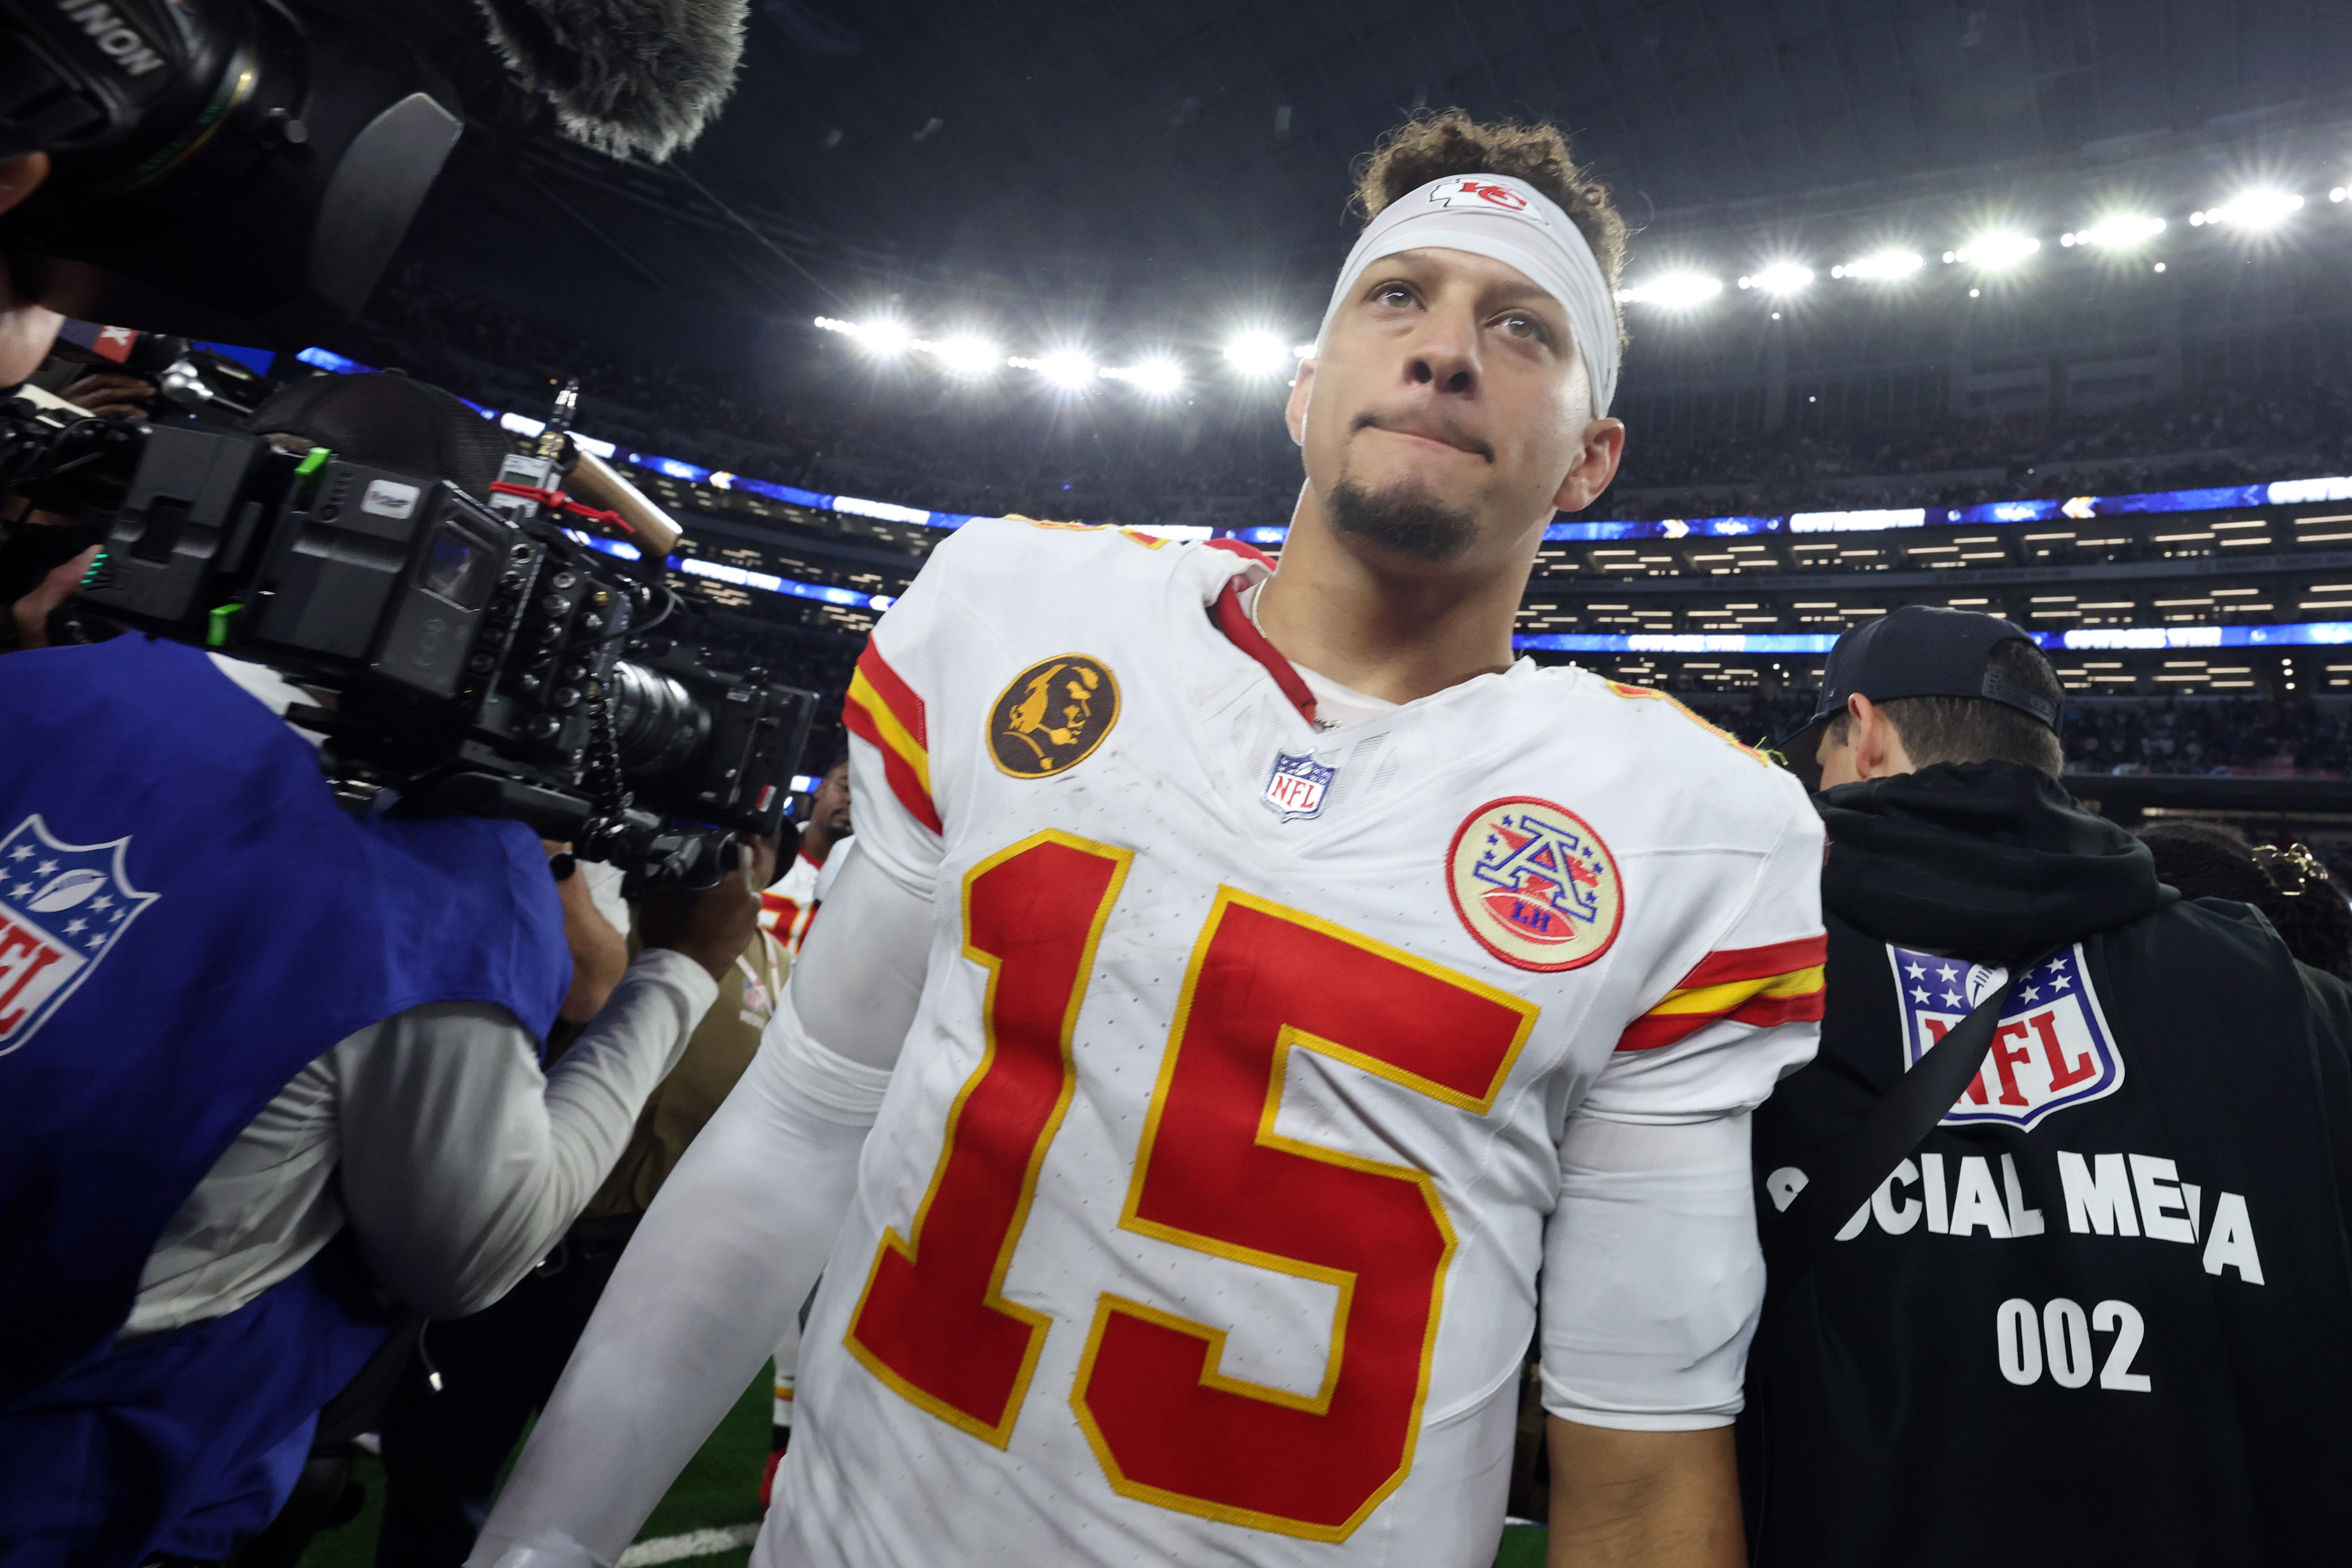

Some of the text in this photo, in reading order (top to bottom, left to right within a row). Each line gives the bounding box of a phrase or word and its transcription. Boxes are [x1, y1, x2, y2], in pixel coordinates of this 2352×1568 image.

[1271, 775, 1315, 809] NFL
[1511, 901, 1551, 932] LH
[0, 914, 64, 1035] FL
[843, 828, 1541, 1544] 15
[1766, 1150, 2265, 1286] CIAL MEA
[1996, 1297, 2152, 1393] 002
